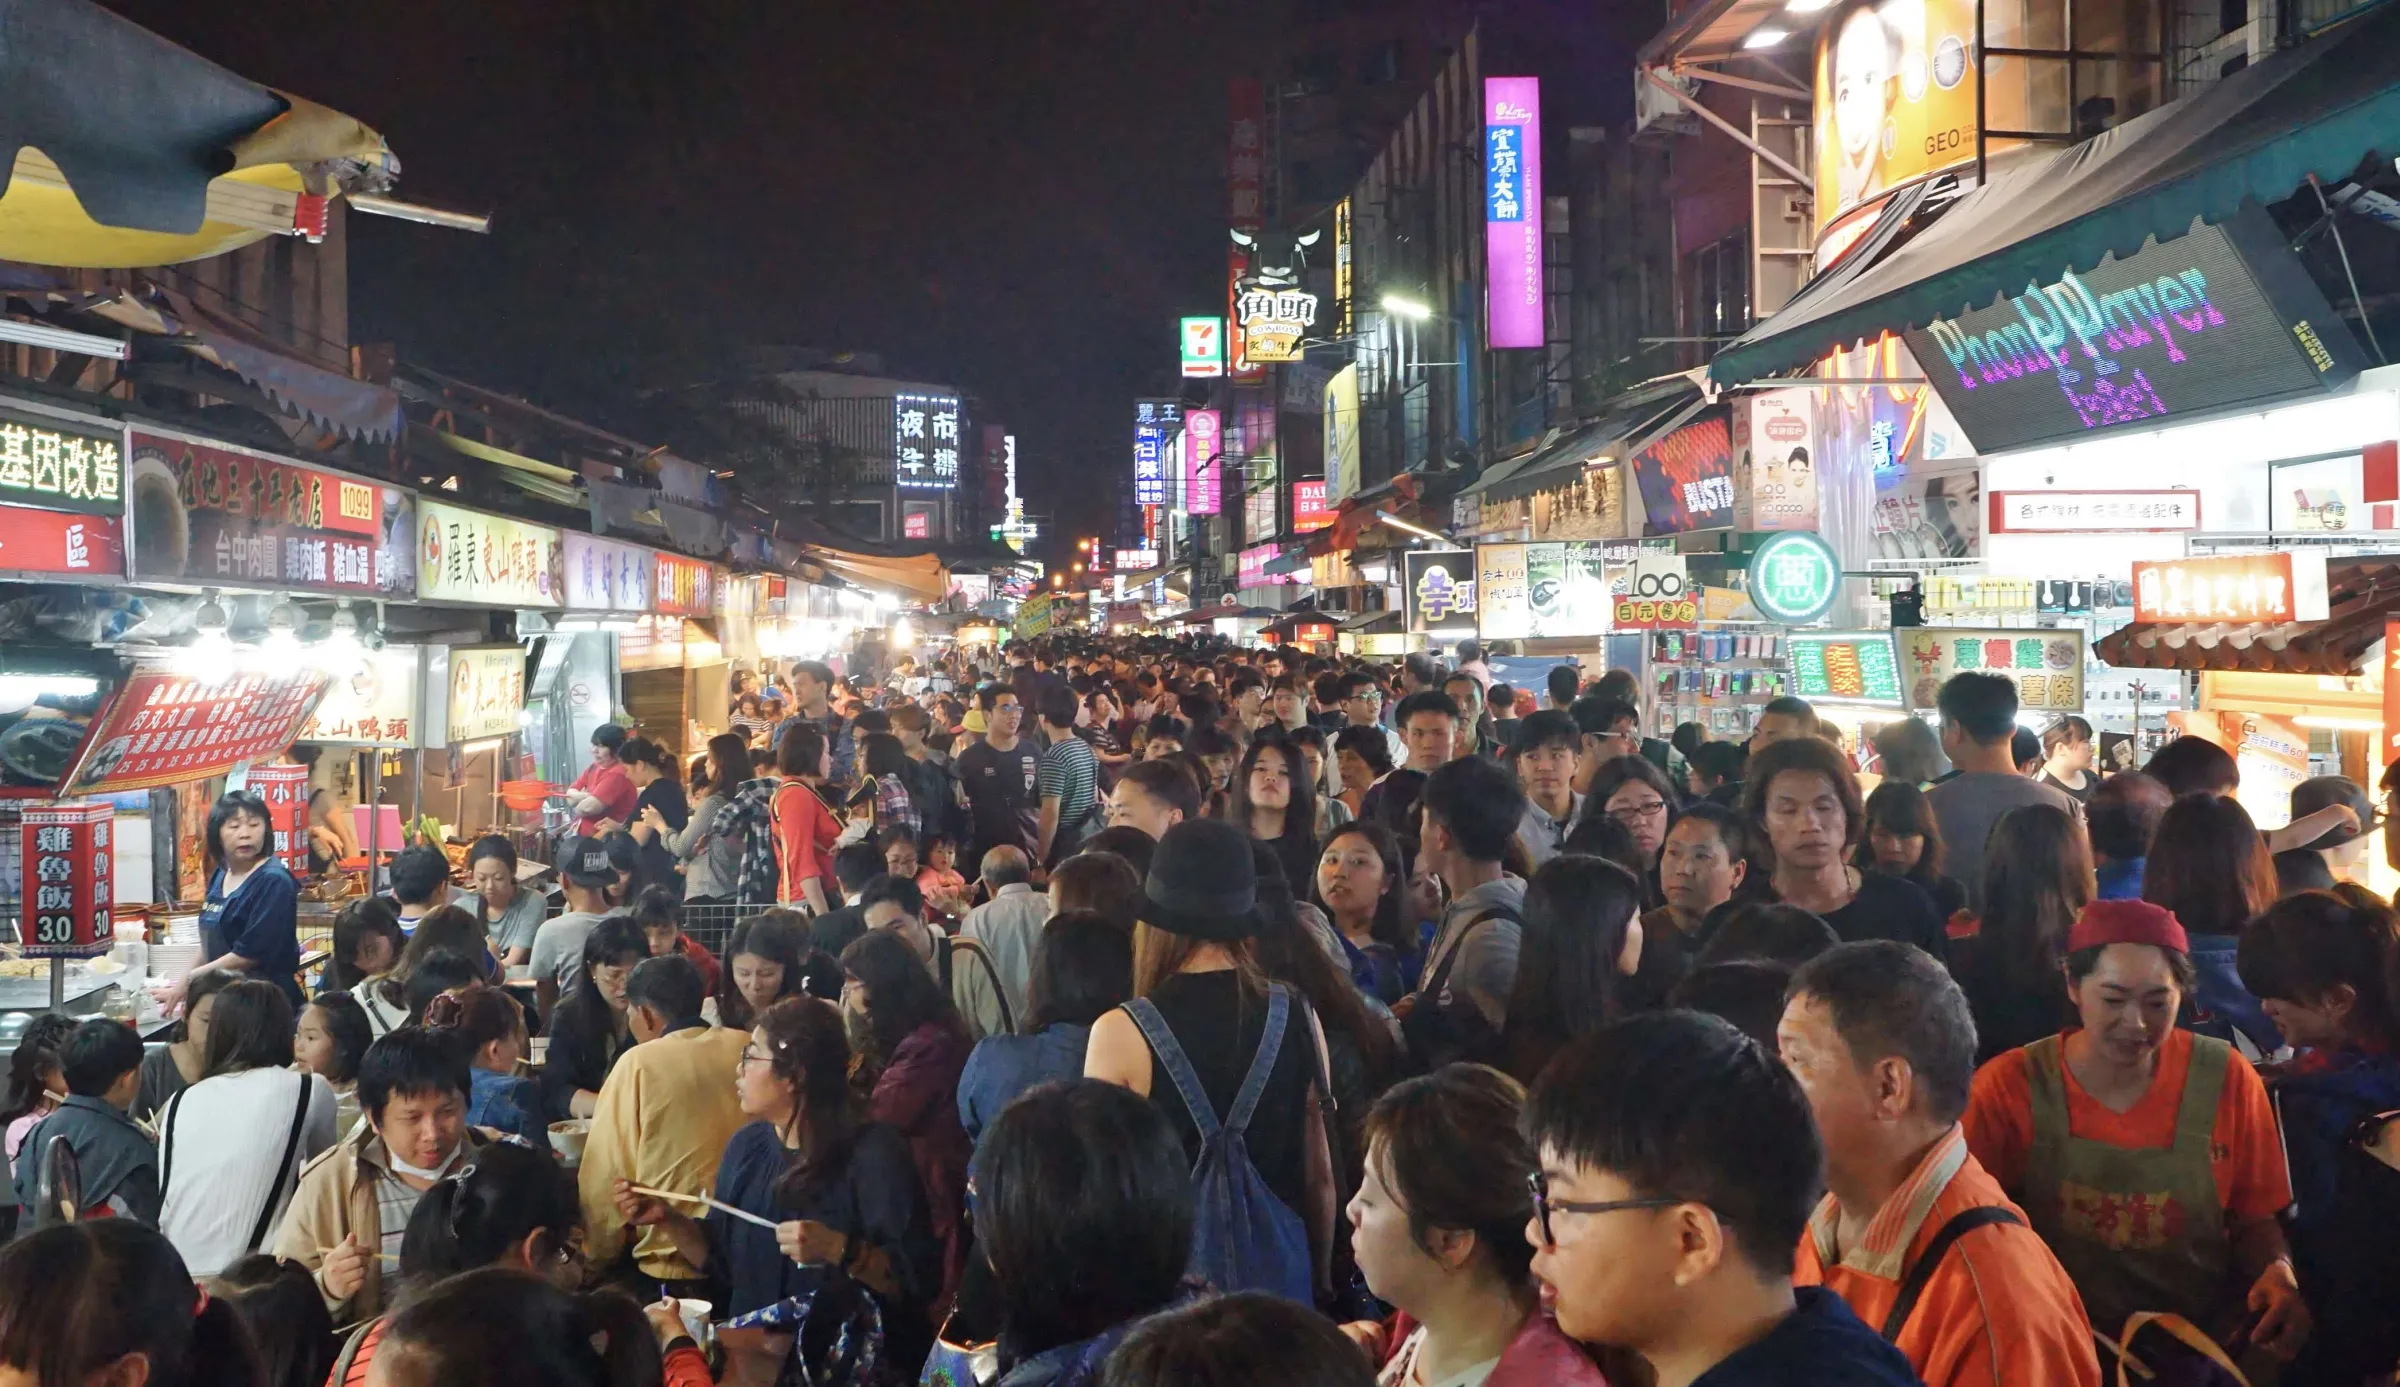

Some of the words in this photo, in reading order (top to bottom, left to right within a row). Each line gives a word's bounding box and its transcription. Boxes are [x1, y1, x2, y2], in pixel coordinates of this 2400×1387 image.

[1925, 129, 1959, 155] GEO
[1491, 128, 1519, 218] 宜蘭大餅
[1238, 292, 1317, 326] 角頭
[901, 409, 955, 439] 夜市
[1137, 403, 1181, 423] 麗王
[0, 422, 119, 500] 基因改造
[902, 447, 957, 476] 牛排
[342, 482, 370, 517] 1099
[65, 523, 90, 569] 區
[215, 529, 278, 579] 台中肉圓
[285, 537, 326, 582] 雞肉飯
[333, 542, 368, 584] 豬血湯
[1627, 560, 1682, 598] 100
[1953, 638, 2044, 669] 蔥爆雞
[2021, 675, 2074, 707] 薯條
[301, 717, 408, 742] 東山鴨頭
[2290, 747, 2304, 758] 60
[2289, 771, 2303, 782] 60
[94, 909, 109, 937] 30
